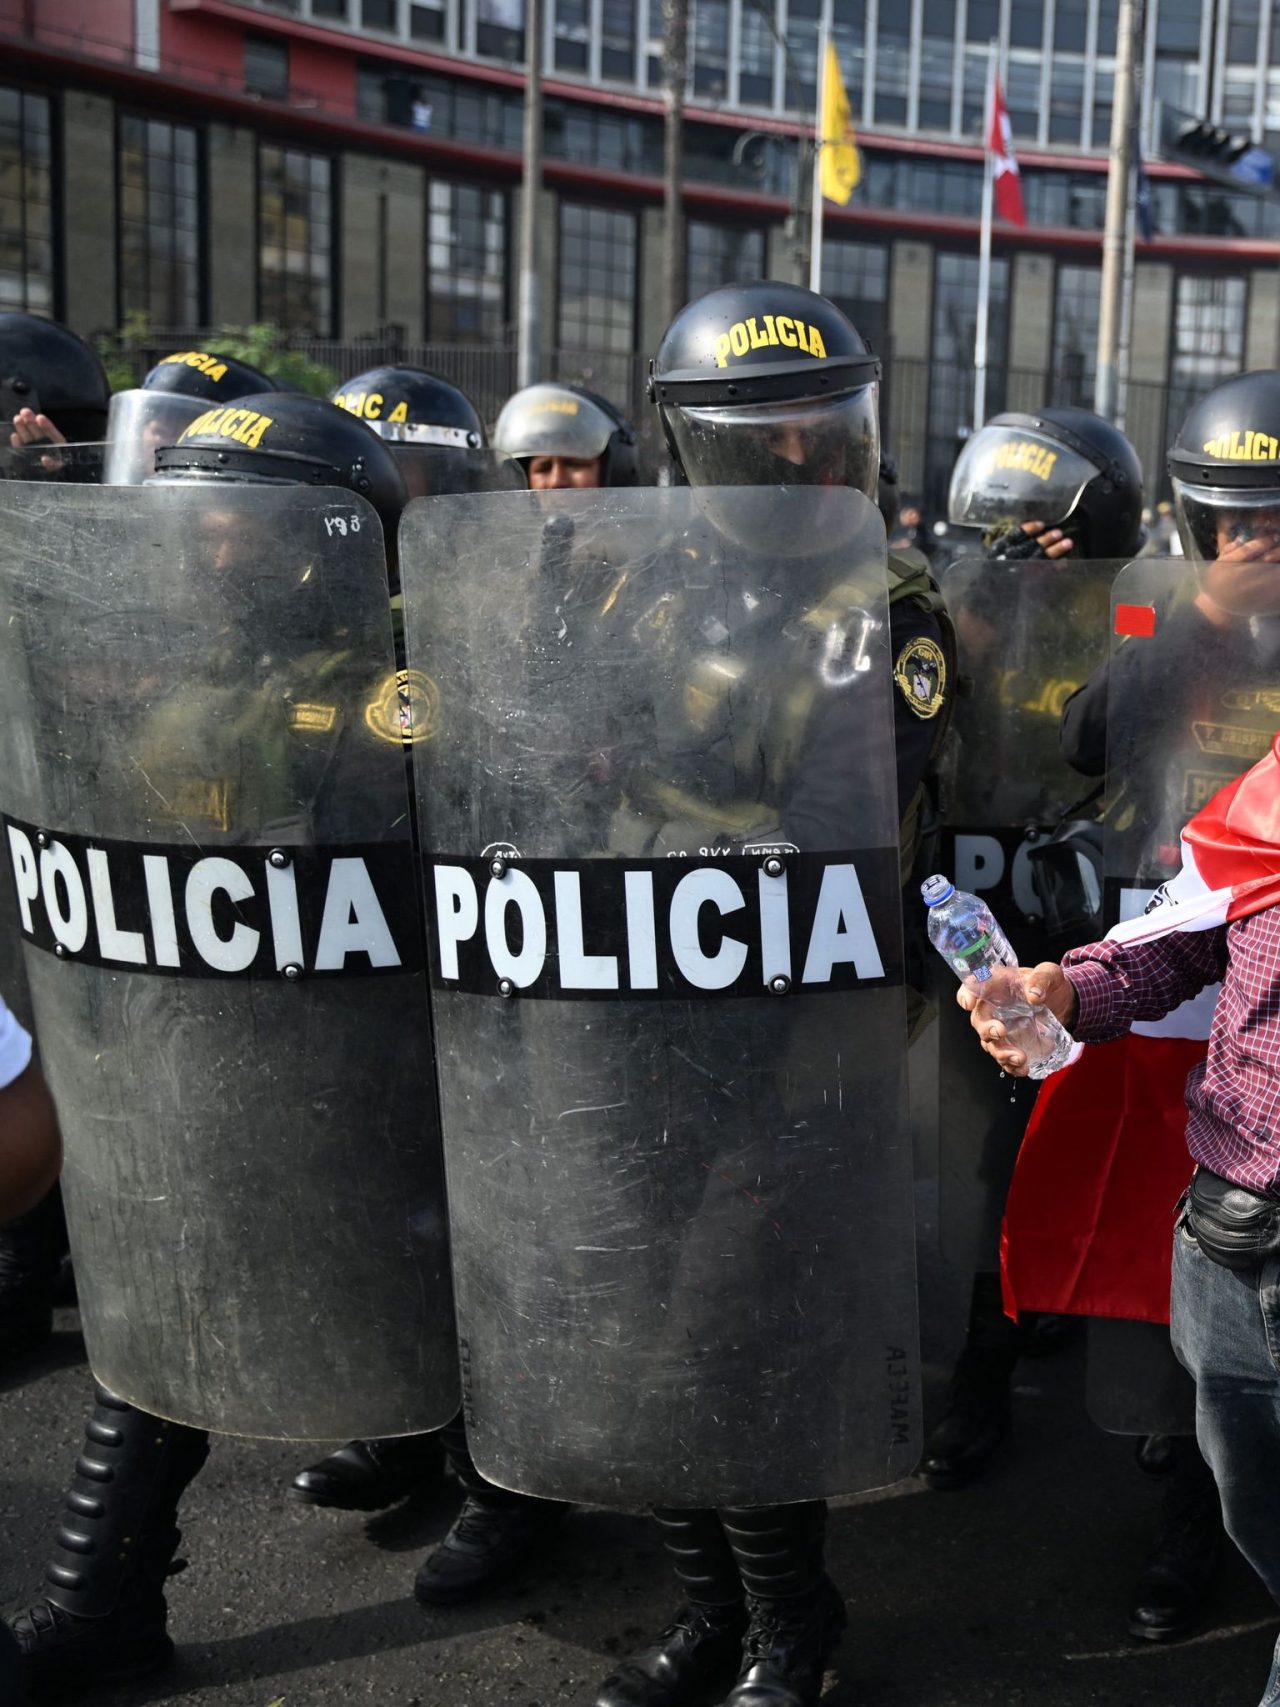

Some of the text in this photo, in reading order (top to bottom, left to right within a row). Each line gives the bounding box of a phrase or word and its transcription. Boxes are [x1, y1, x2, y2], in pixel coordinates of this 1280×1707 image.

[715, 315, 828, 368] POLICIA
[6, 824, 403, 973] POLICIA
[433, 864, 886, 990] POLICIA
